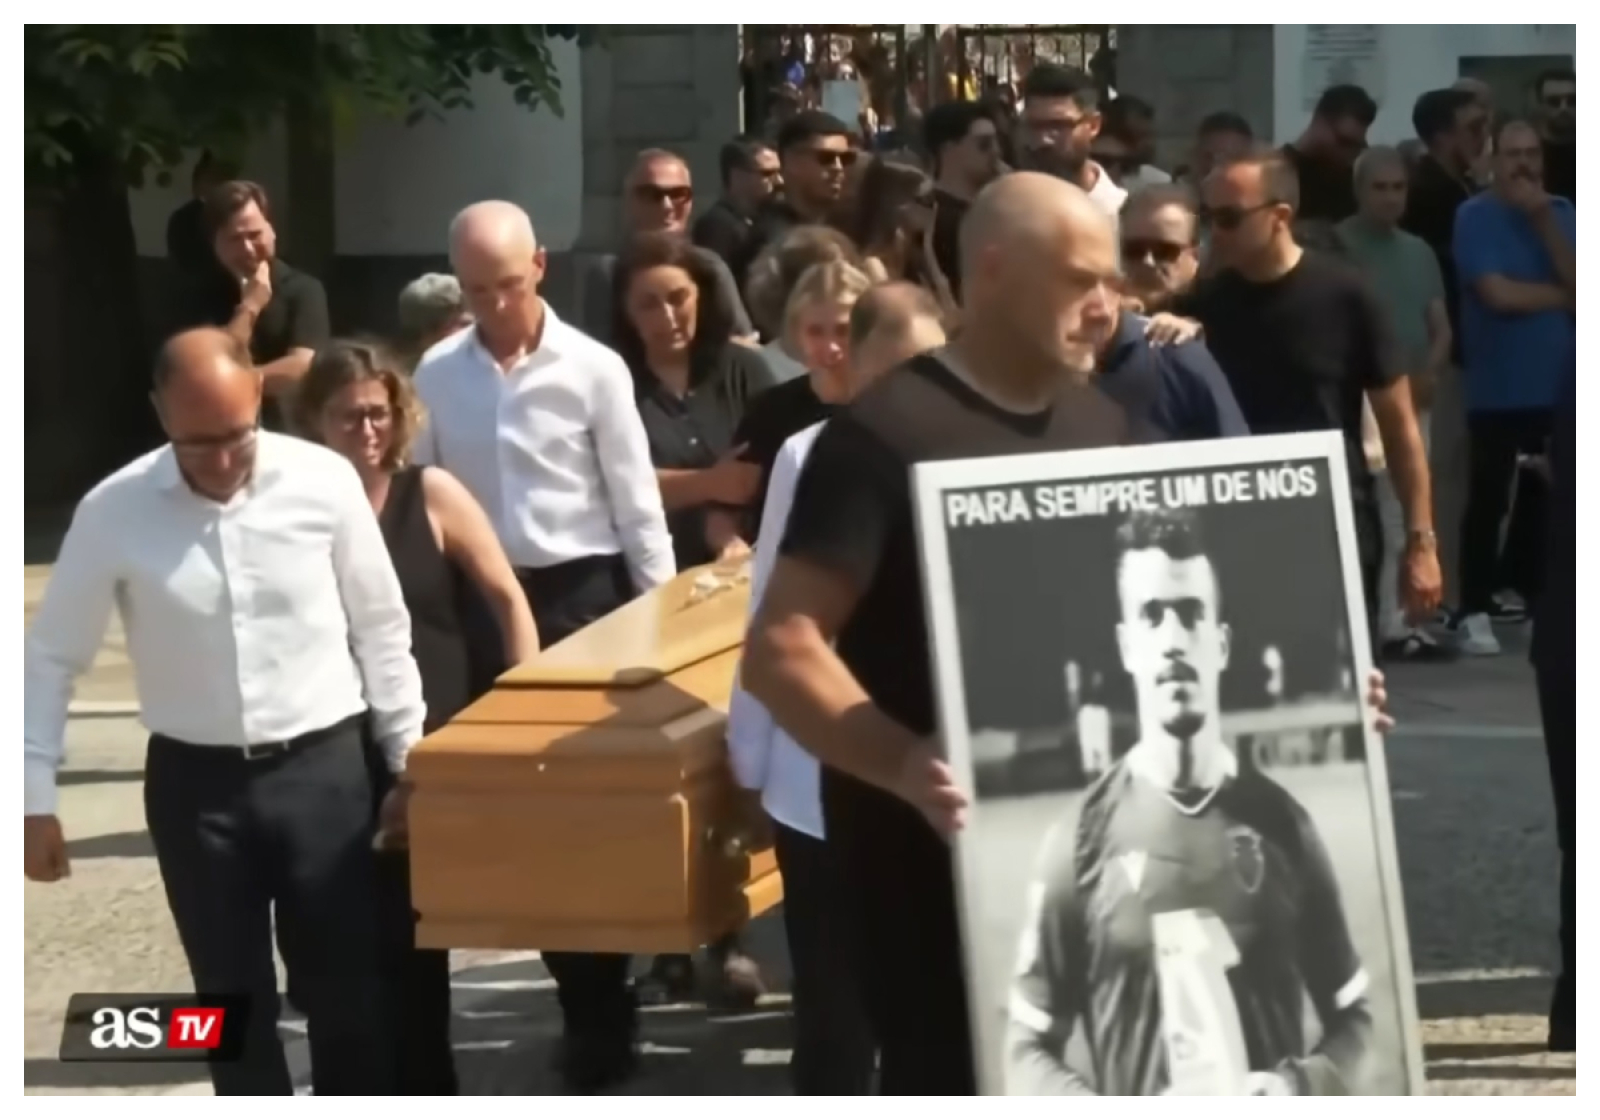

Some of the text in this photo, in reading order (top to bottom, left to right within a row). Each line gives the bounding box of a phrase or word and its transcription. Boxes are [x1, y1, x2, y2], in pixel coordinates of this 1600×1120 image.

[947, 462, 1317, 527] PARA SEMPRE UM DE NÓS
